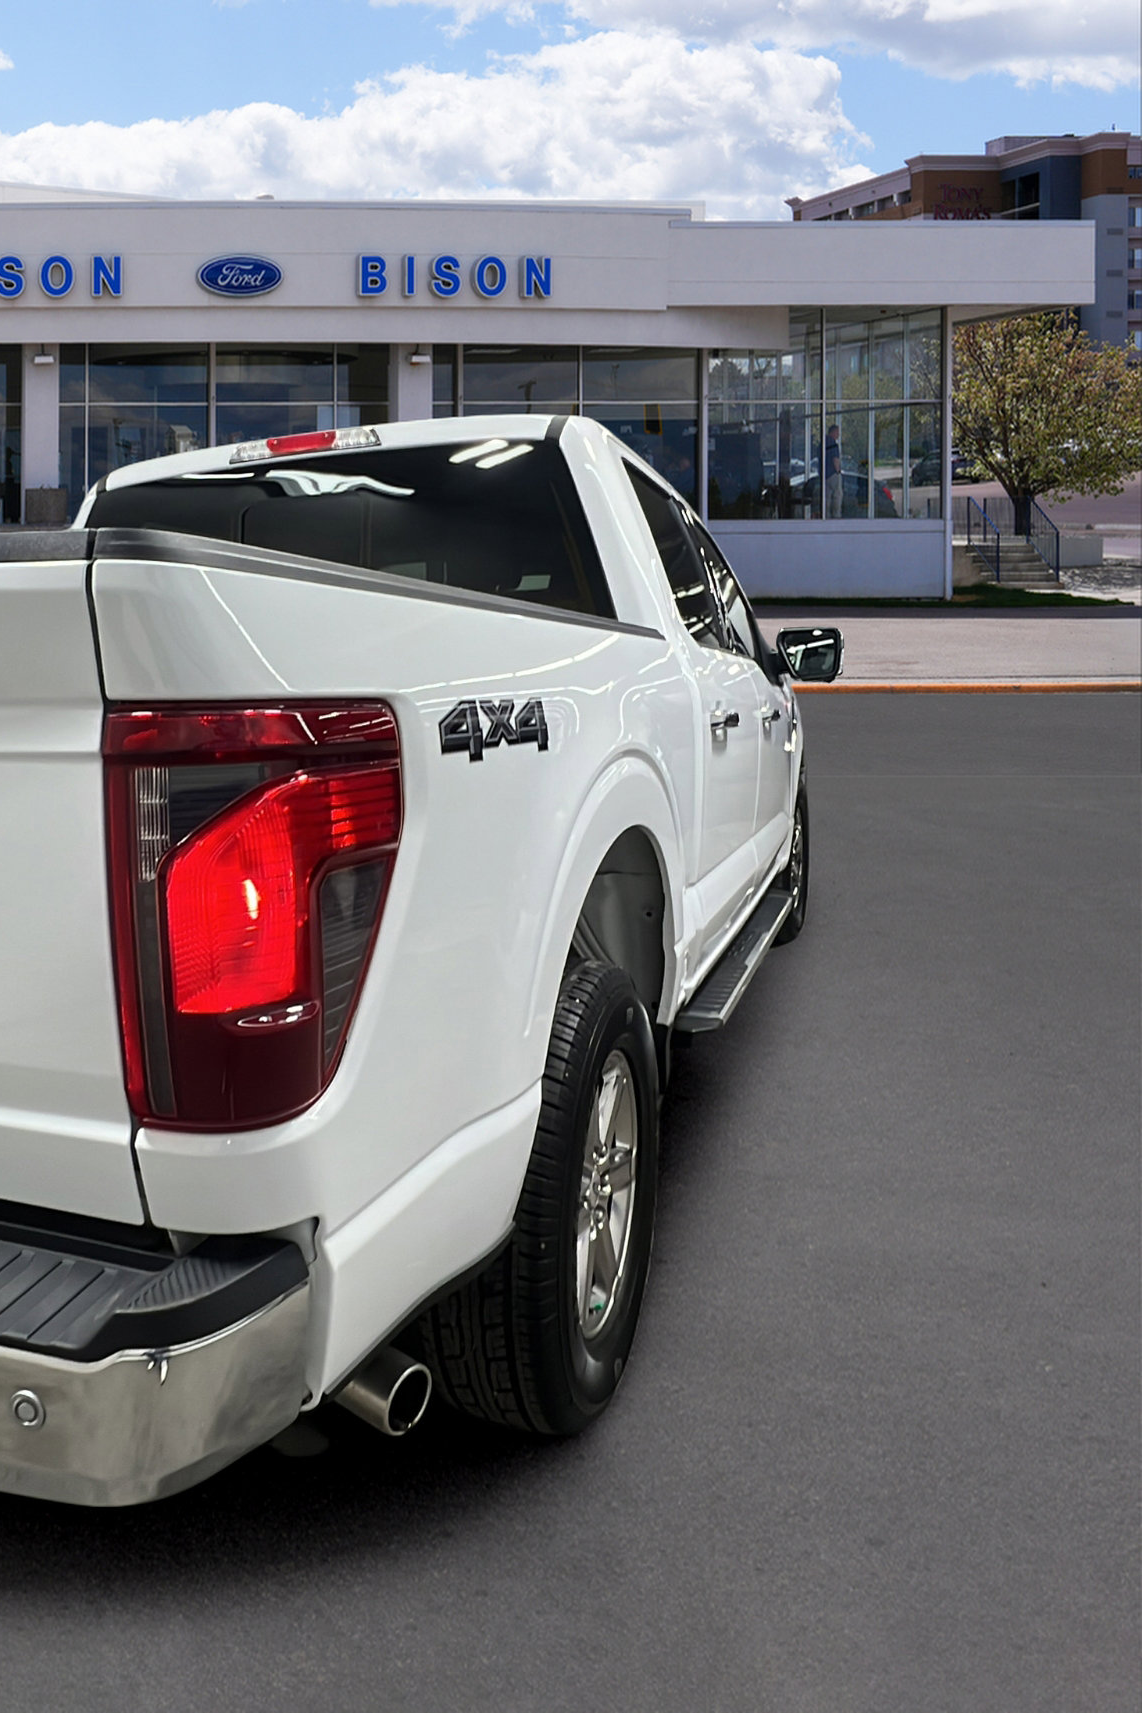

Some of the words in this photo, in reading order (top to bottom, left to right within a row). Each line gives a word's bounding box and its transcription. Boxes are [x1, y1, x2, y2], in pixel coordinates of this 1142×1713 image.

[938, 184, 984, 201] TONY
[217, 263, 266, 286] Ford
[357, 254, 553, 299] BISON
